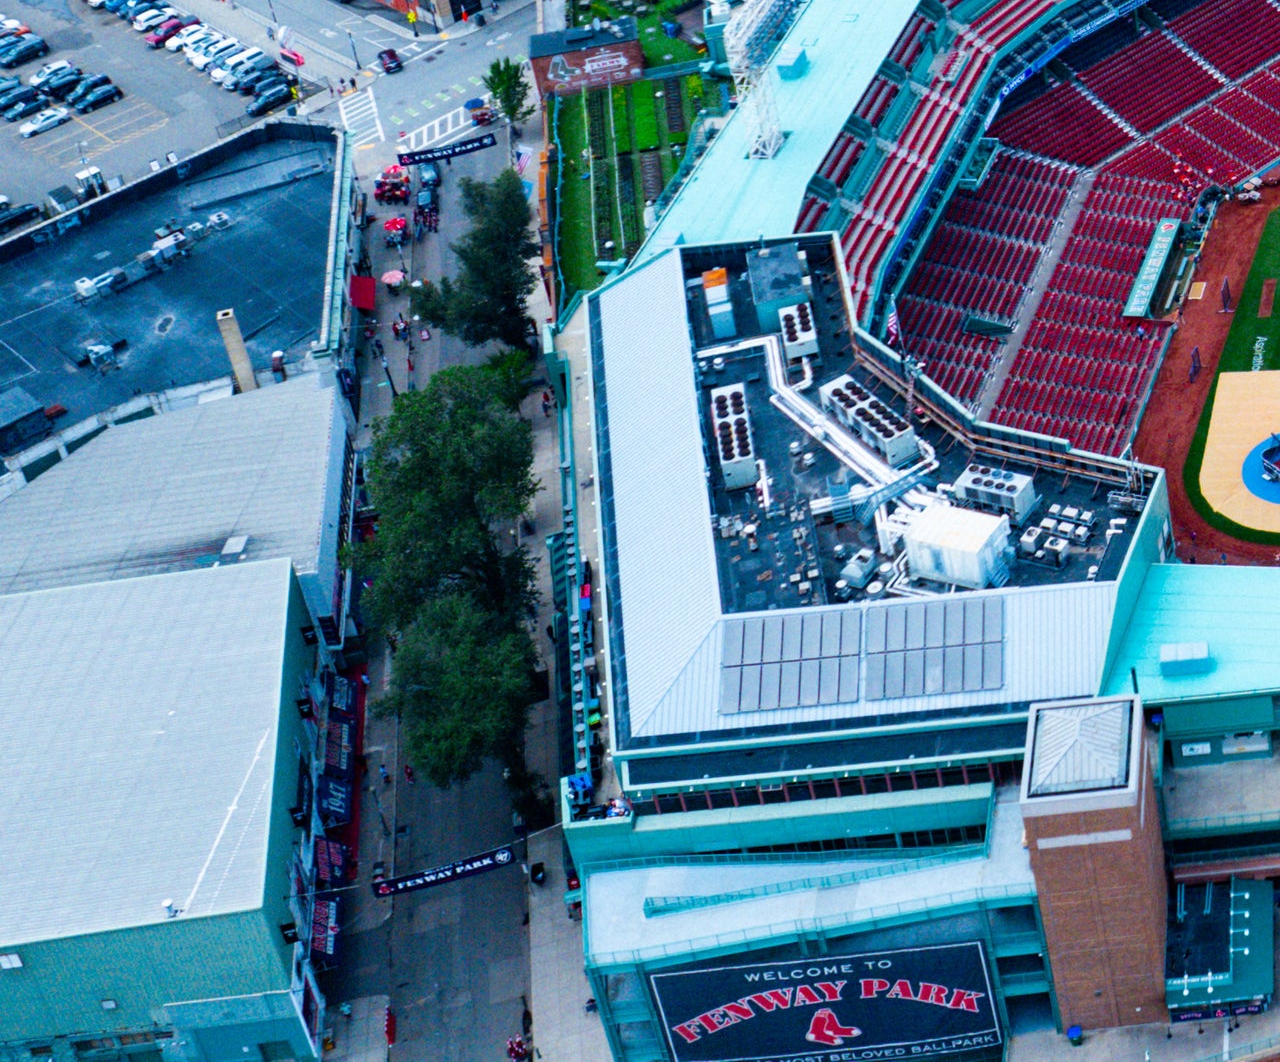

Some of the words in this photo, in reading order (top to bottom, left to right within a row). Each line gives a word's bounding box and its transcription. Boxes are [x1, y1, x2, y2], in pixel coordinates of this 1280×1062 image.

[1252, 336, 1268, 372] Aspiratio
[397, 869, 453, 889] FENWAY
[456, 857, 494, 873] PARK
[744, 963, 854, 984] WELCOME
[864, 960, 892, 971] TO
[672, 980, 847, 1043] FENWAY
[859, 978, 986, 1013] PARK
[829, 1048, 905, 1062] BELOVED
[911, 1034, 994, 1055] BALLPARK
